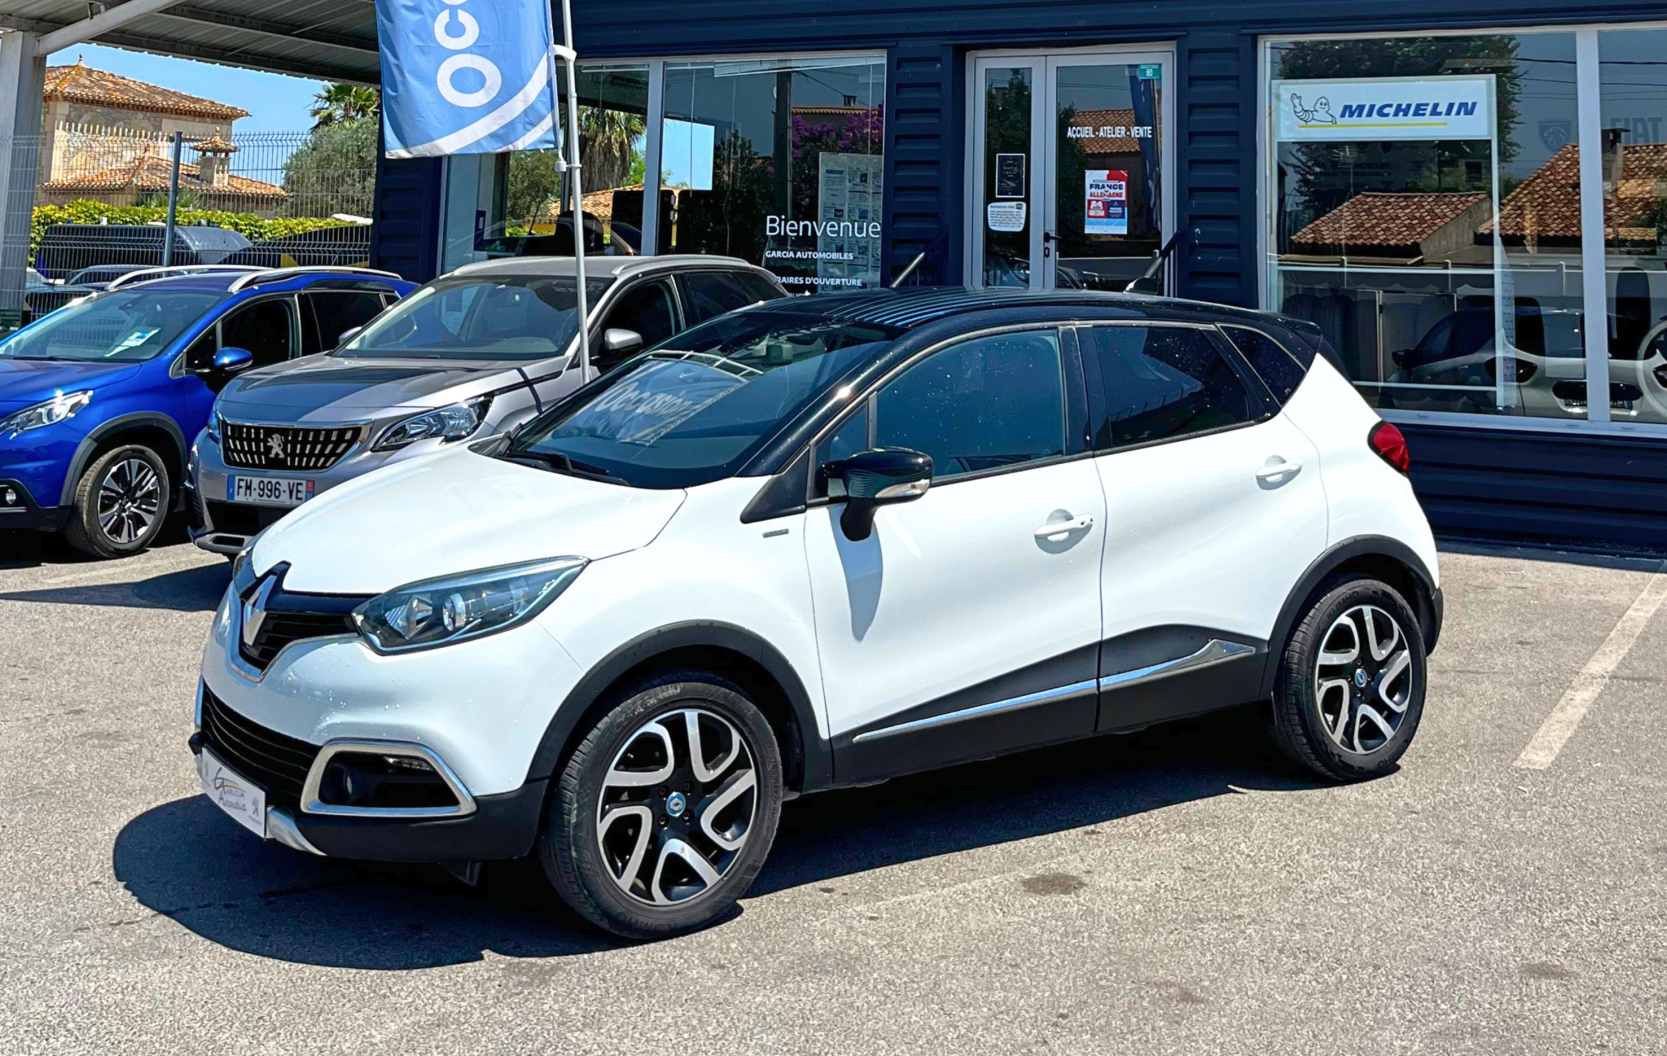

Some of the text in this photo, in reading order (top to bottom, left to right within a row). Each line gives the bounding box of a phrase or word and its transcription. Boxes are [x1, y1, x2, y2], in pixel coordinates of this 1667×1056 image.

[434, 0, 502, 108] Oc
[1339, 101, 1478, 119] MICHELIN
[1066, 126, 1153, 138] ACCUEIL ATELIER VENTE
[1089, 183, 1124, 191] FRANCE
[765, 214, 881, 239] Bienvenue
[765, 250, 854, 260] GARCIA AUTOMOBILES
[776, 276, 863, 287] RAIRES D'OUVERTURE
